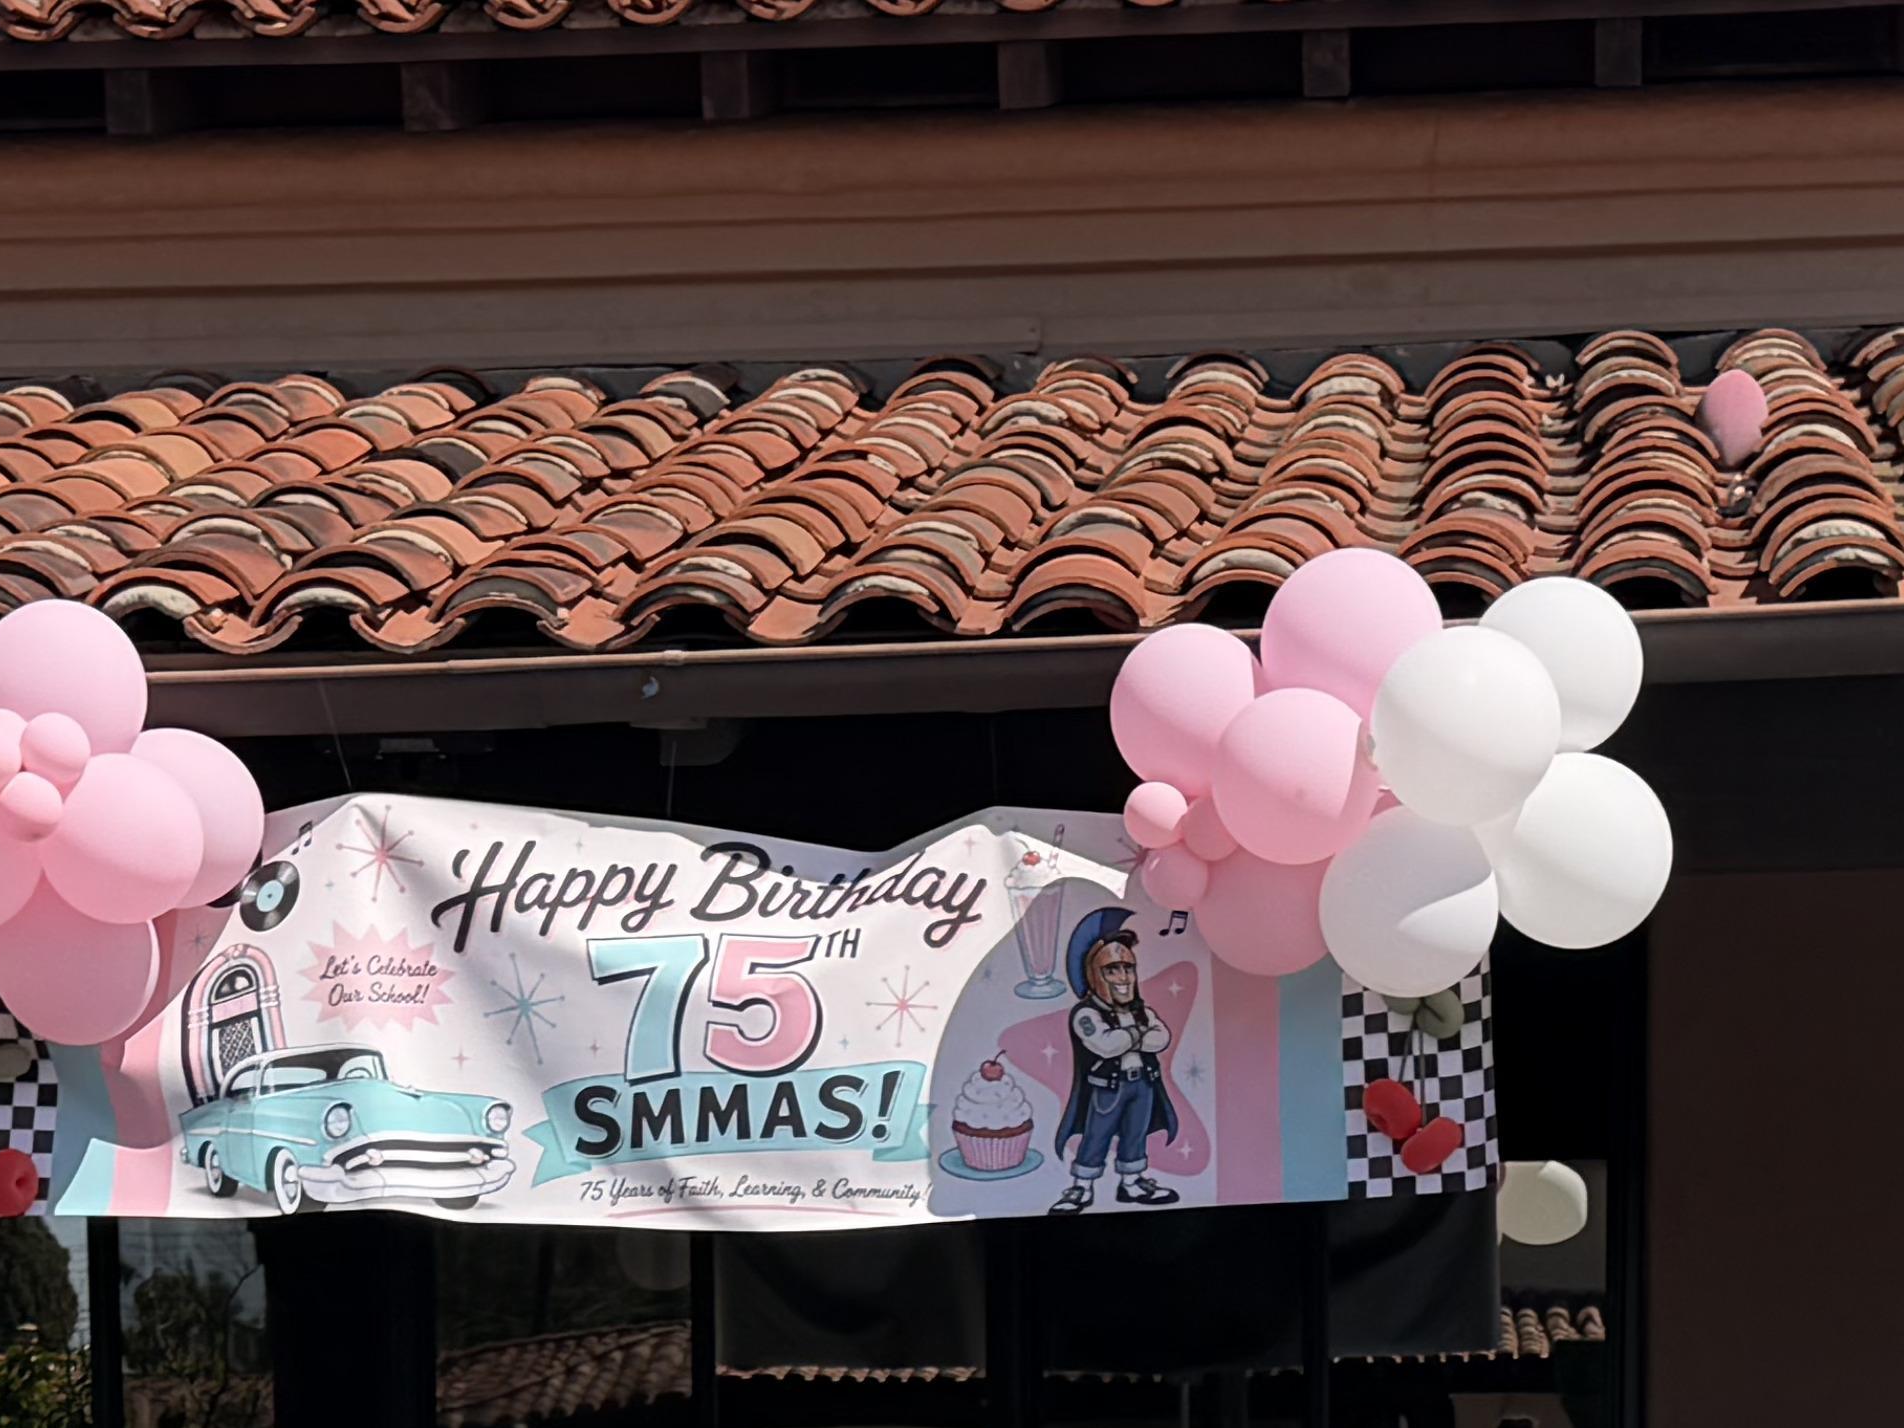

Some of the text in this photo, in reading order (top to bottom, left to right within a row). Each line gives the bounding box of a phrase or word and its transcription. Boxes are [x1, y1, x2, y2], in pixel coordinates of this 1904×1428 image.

[431, 839, 989, 954] Happy Birthday
[319, 954, 438, 980] Let's Celebrate
[327, 981, 430, 1006] Our School!
[573, 1070, 904, 1158] SMMAS!
[580, 1175, 931, 1207] 75 Years of Faith, Learning, & Community!
